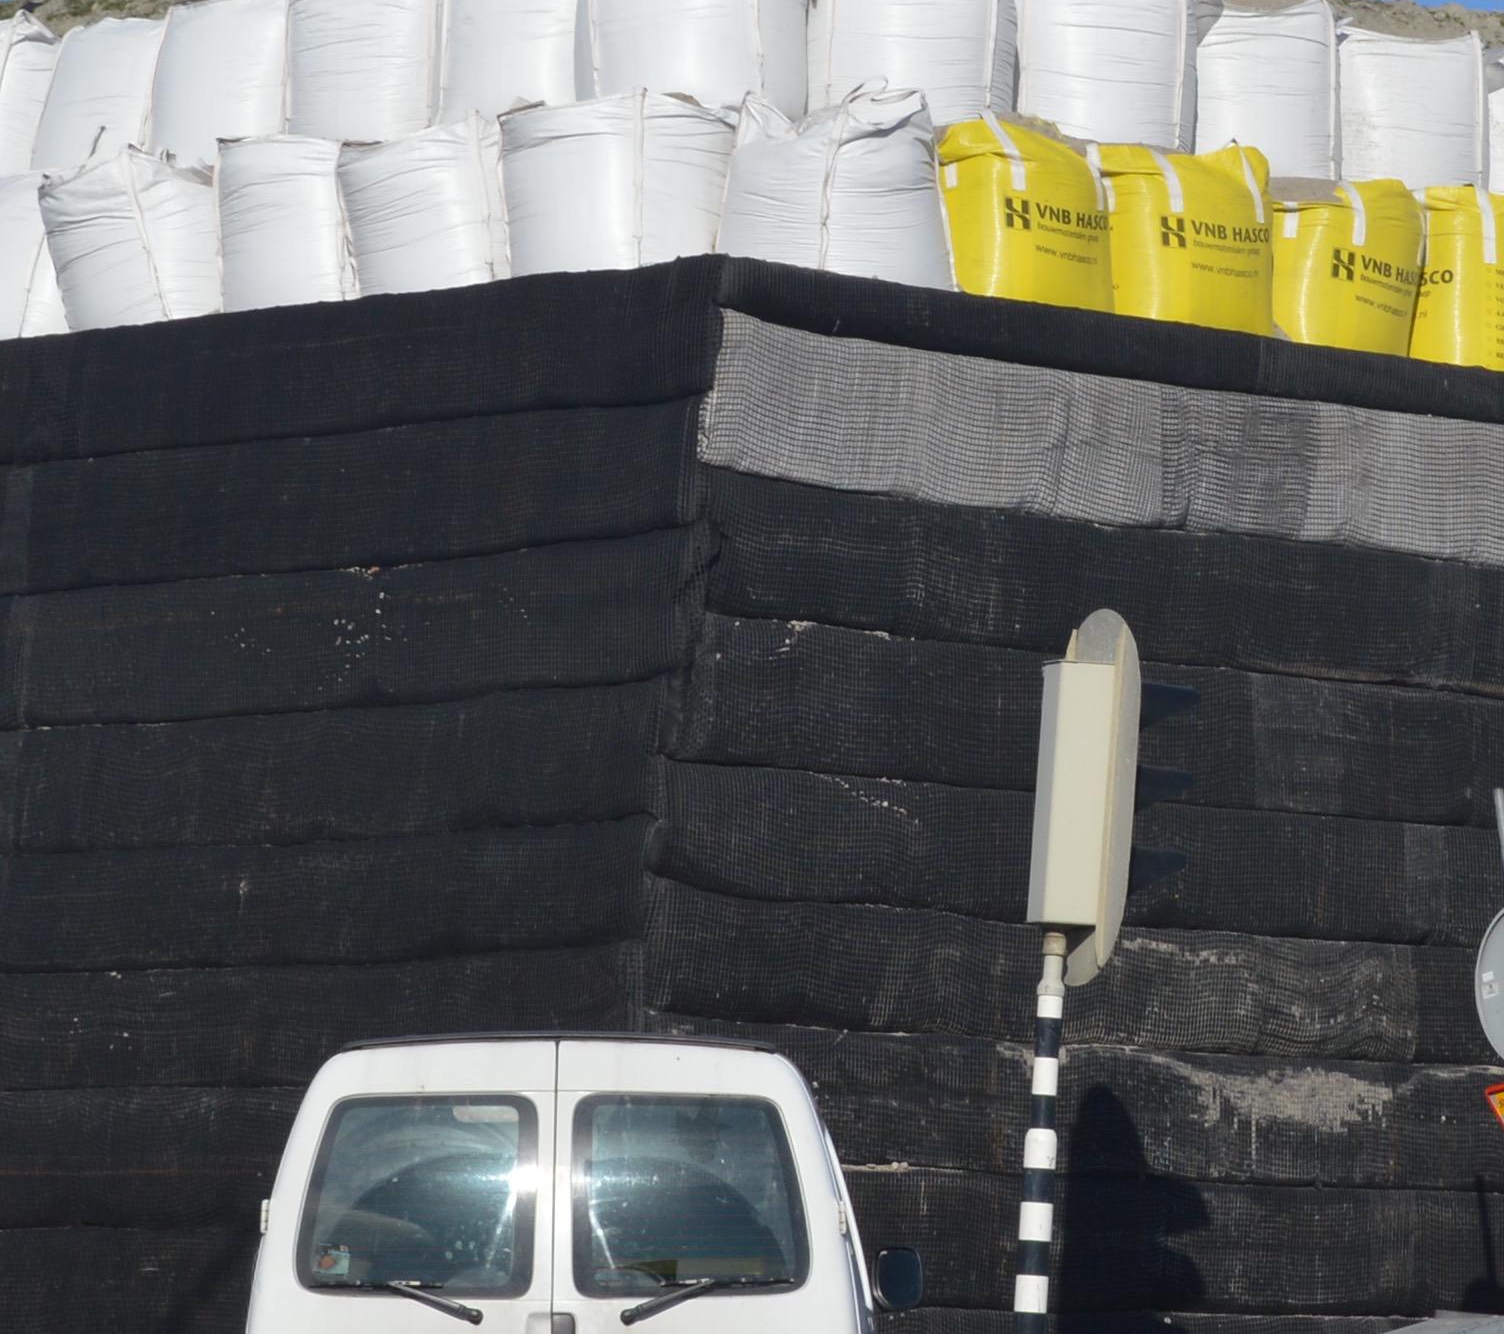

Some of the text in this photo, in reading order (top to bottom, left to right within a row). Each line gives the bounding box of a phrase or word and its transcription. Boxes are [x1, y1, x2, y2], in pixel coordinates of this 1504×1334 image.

[1036, 202, 1072, 225] VNB
[1191, 220, 1270, 244] VNB HASCO
[1361, 255, 1392, 278] VNB
